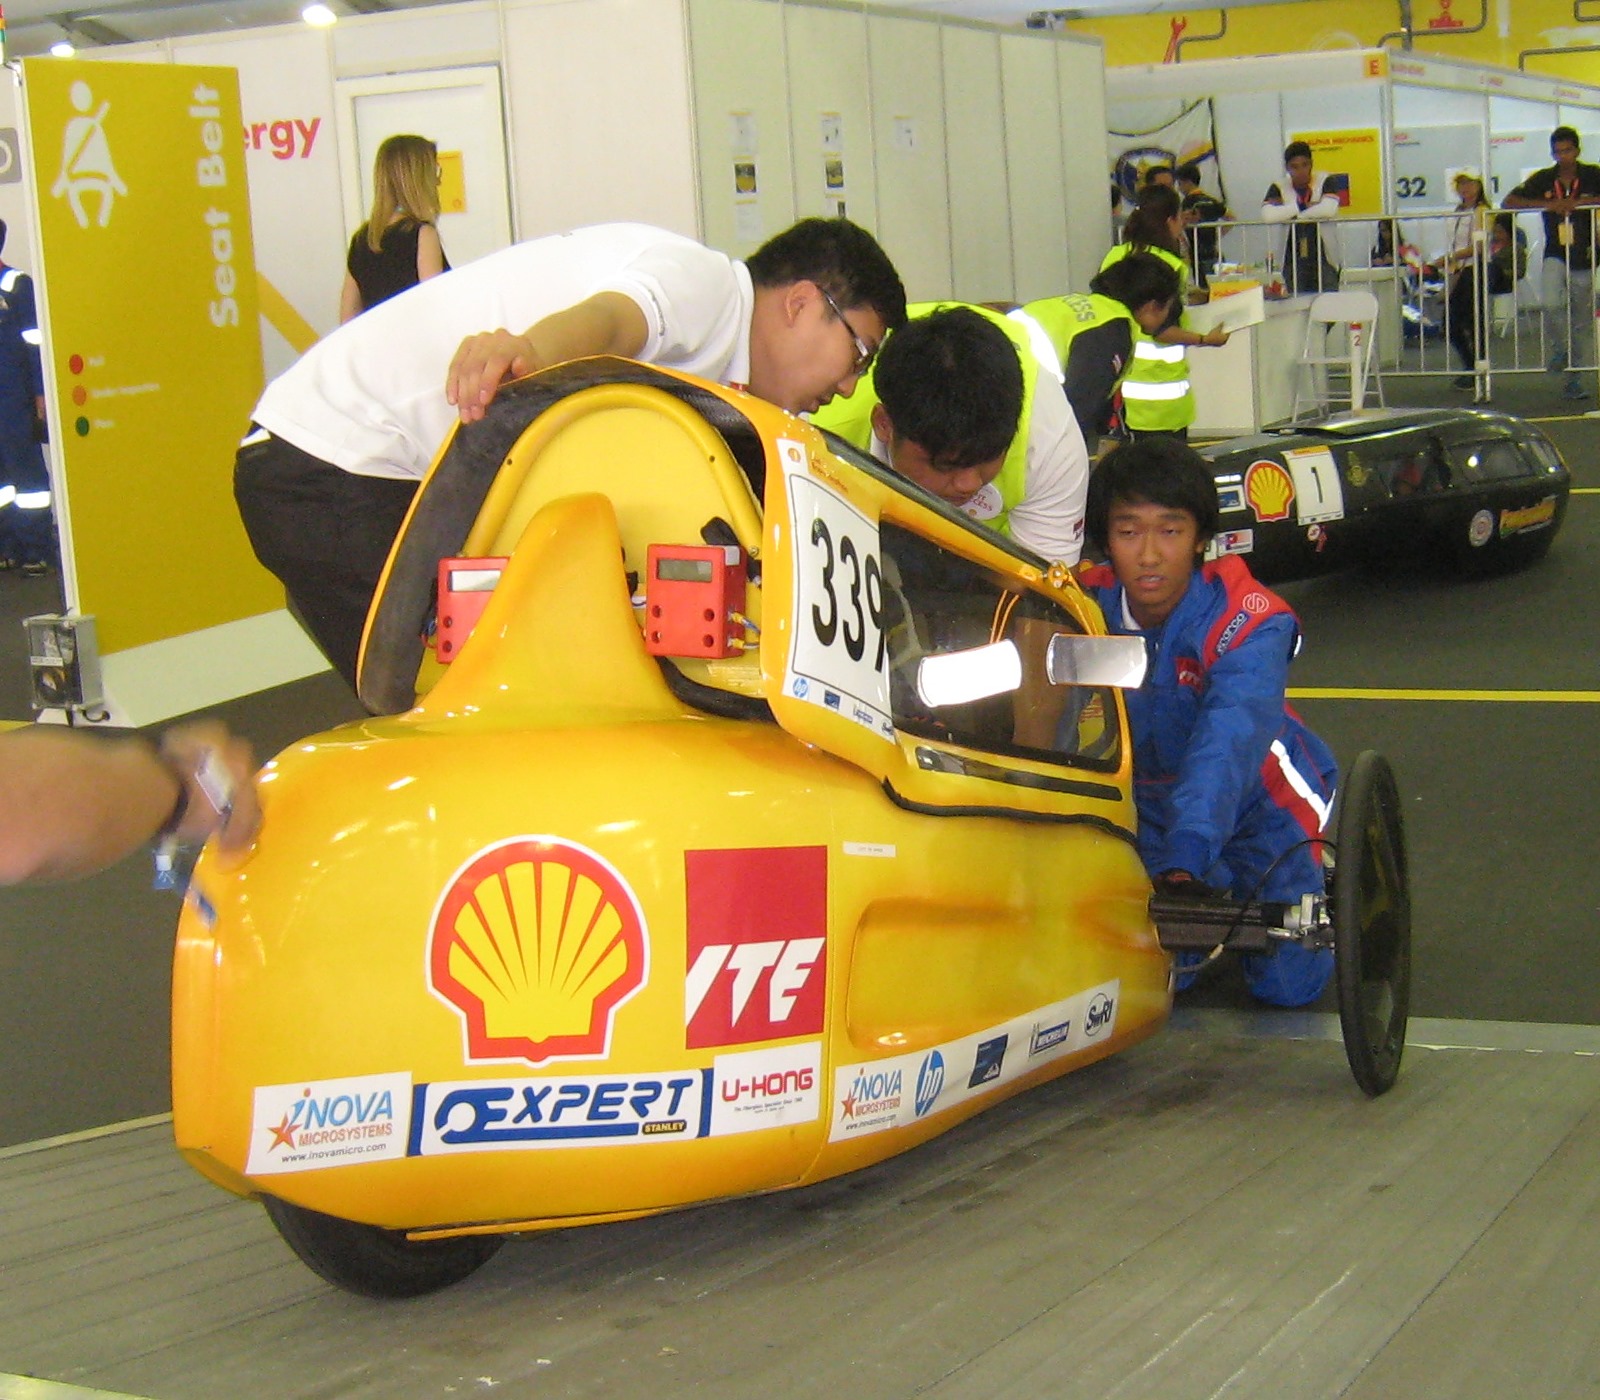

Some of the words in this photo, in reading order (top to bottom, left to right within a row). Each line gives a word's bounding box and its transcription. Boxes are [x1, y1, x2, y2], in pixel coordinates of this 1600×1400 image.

[1369, 59, 1381, 76] E
[188, 83, 227, 187] Belt
[1396, 176, 1427, 198] 32
[204, 207, 239, 328] Seat
[1353, 334, 1362, 347] 2
[1310, 466, 1324, 504] 1
[811, 517, 886, 674] 339
[684, 936, 826, 1029] ITE
[722, 1067, 813, 1102] U-HONG
[914, 1049, 945, 1118] hp
[298, 1122, 393, 1147] MICROSYSTEMS
[643, 1121, 686, 1134] STANLEY
[281, 1142, 387, 1163] www.inovamicro.com
